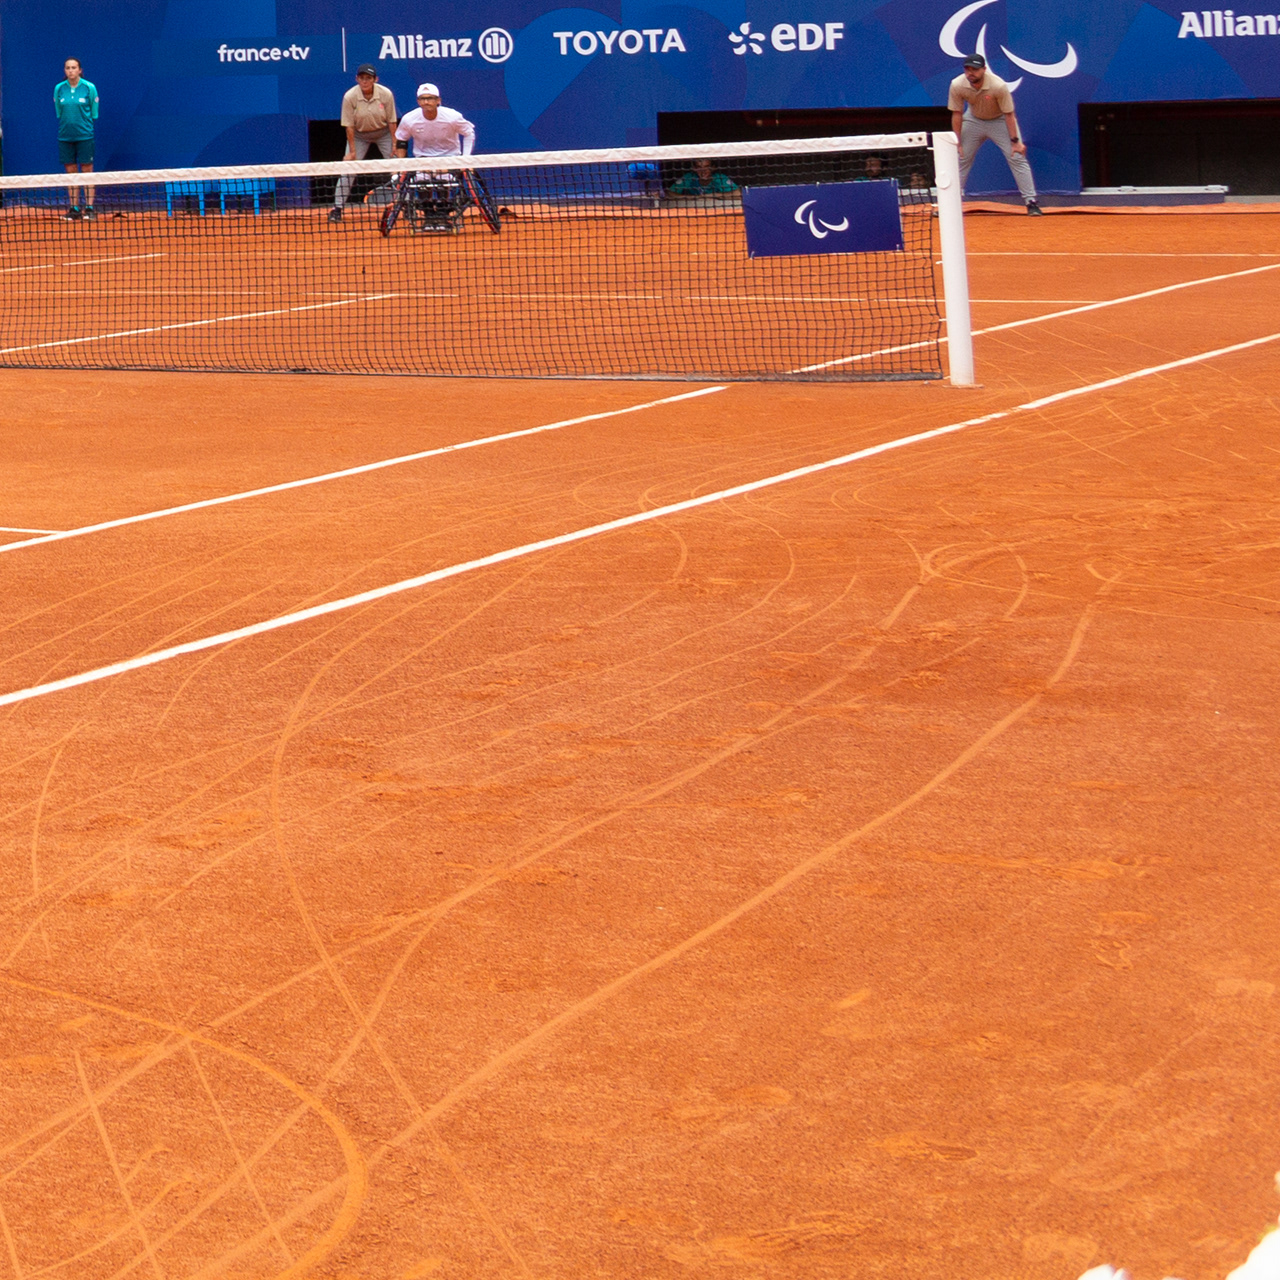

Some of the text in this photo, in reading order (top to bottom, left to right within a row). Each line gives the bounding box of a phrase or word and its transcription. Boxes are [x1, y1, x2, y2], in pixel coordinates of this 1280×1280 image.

[1177, 10, 1280, 38] Allian
[379, 35, 472, 59] Allianz
[553, 28, 686, 55] TOYOTA
